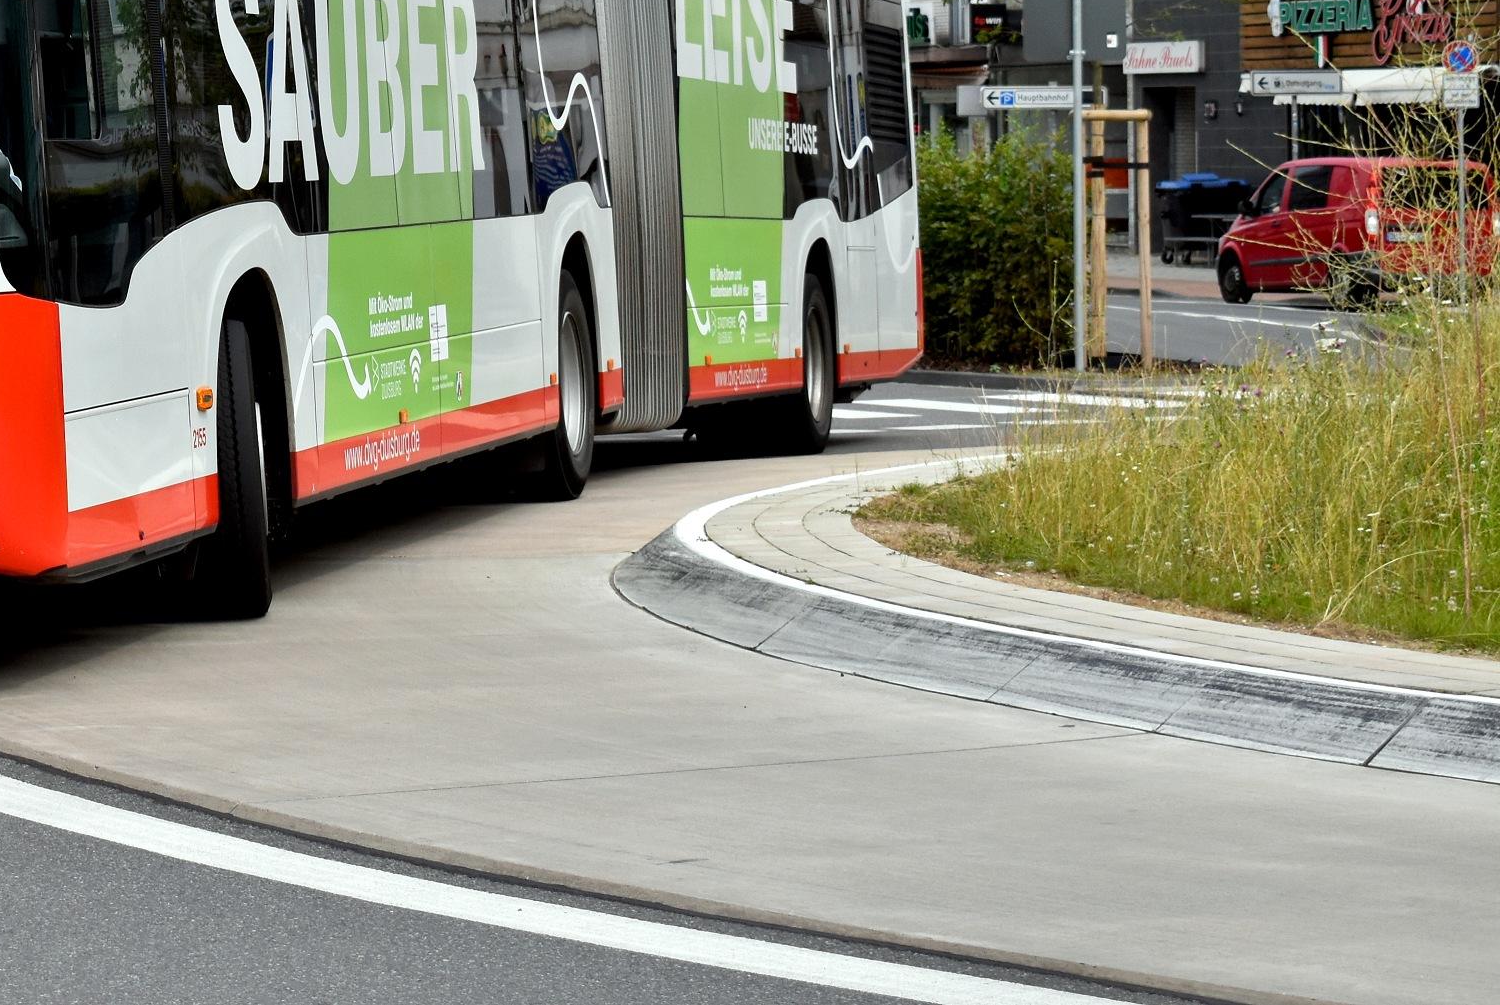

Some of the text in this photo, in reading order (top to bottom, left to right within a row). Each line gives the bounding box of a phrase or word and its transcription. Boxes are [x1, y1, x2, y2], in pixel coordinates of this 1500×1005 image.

[1017, 92, 1070, 103] Hauptbahnhof
[748, 117, 818, 155] UNSERE E-BUSSE
[192, 427, 207, 449] 2155
[343, 424, 421, 472] www.dvg-duisburg.de
